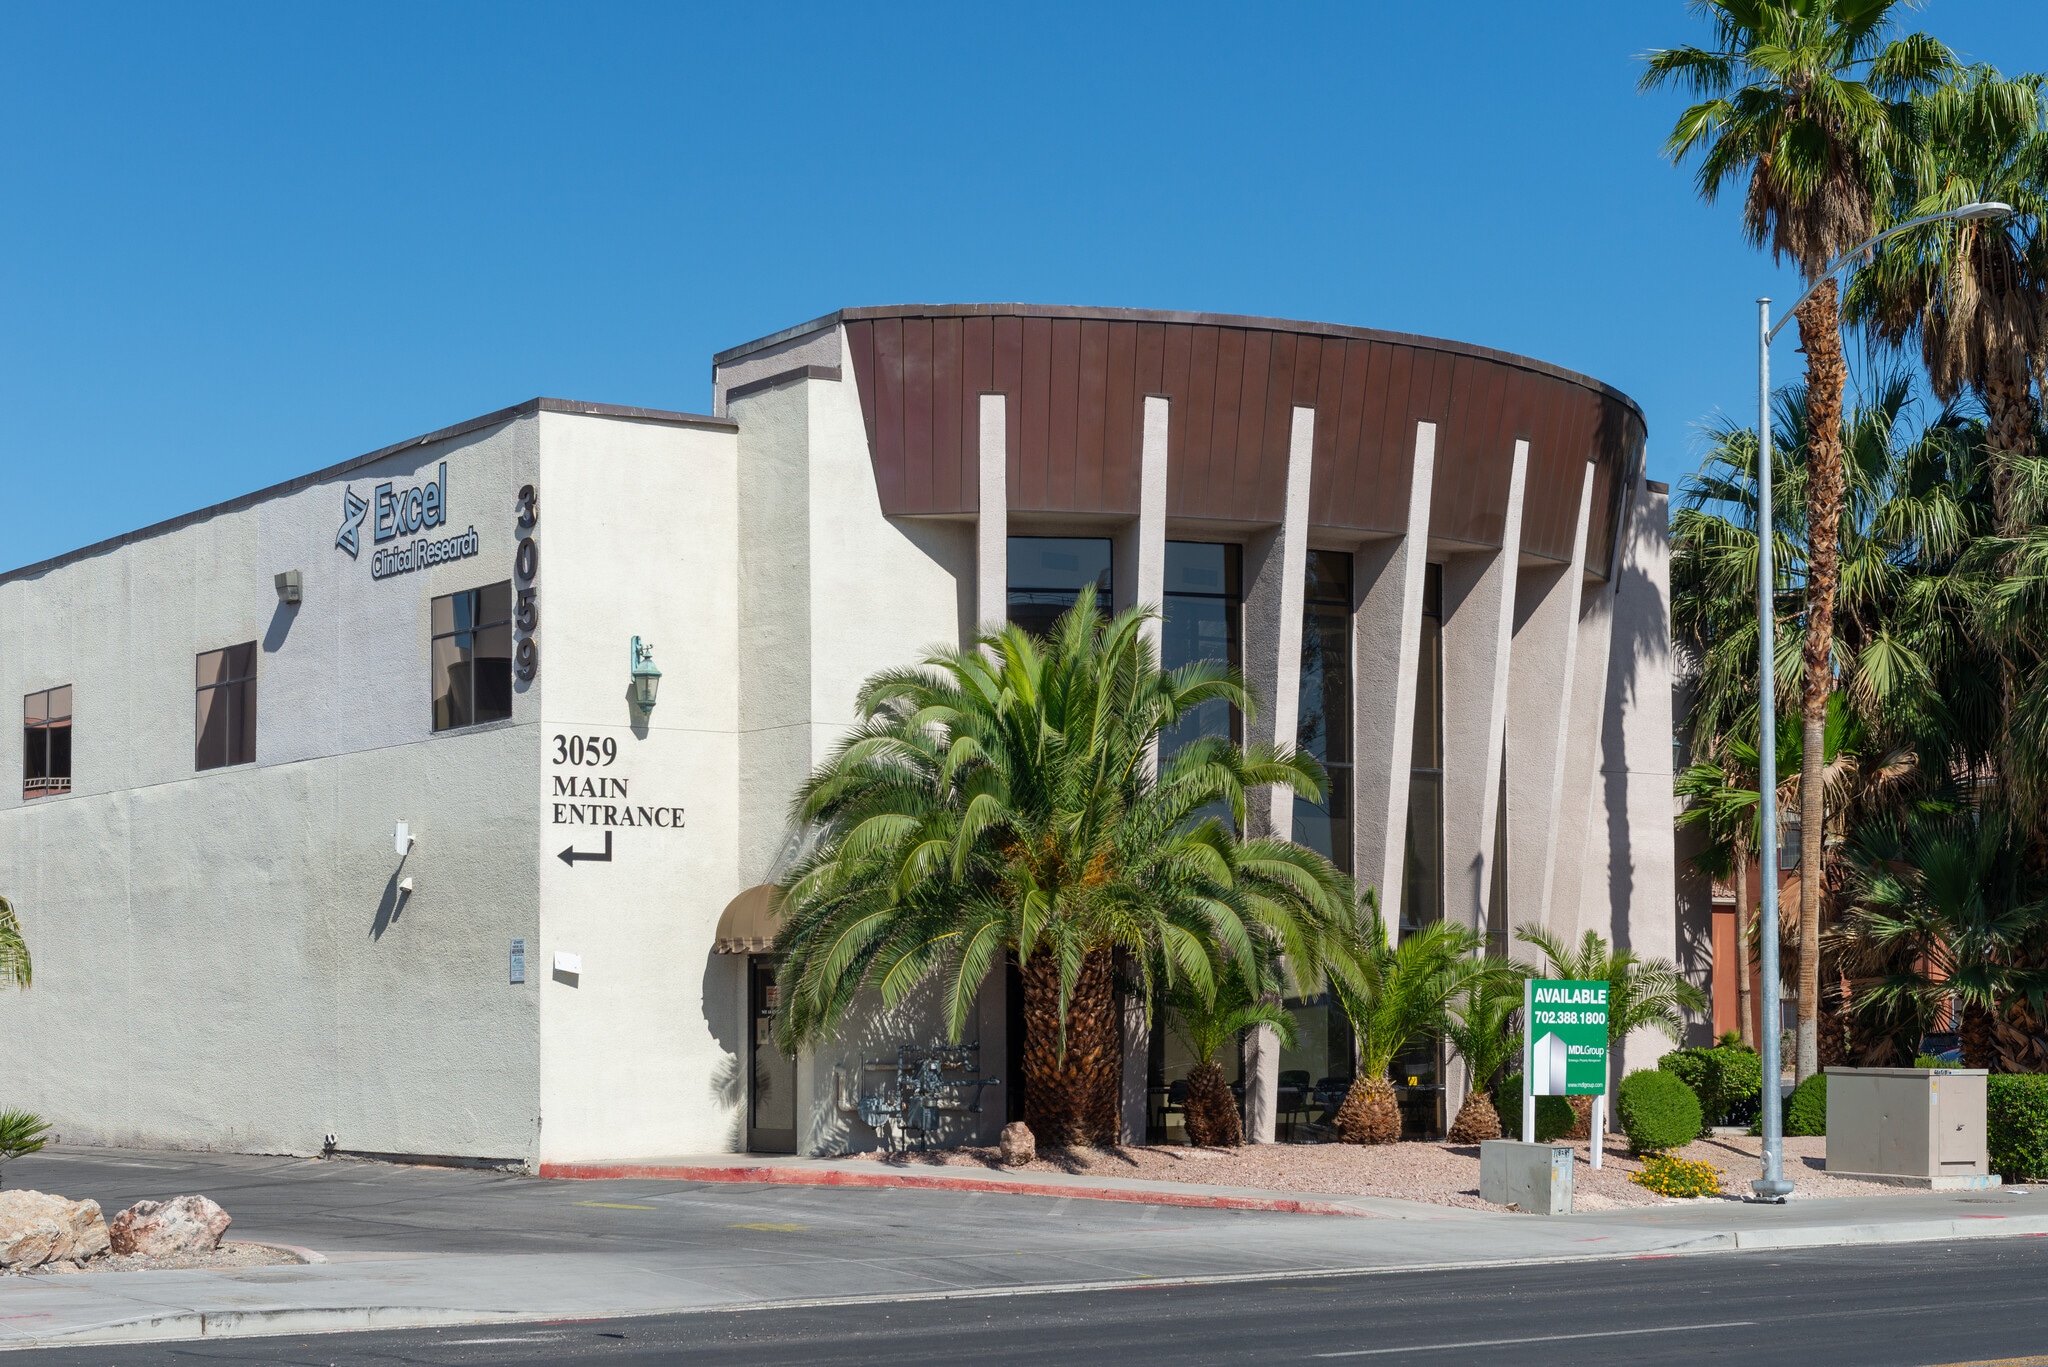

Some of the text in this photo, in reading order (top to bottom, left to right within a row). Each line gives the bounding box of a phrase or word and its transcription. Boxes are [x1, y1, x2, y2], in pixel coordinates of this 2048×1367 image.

[374, 461, 447, 542] Excel
[372, 525, 478, 579] Clinical Research
[516, 484, 538, 681] 3059
[552, 734, 617, 766] 3059
[552, 775, 629, 798] MAIN
[552, 803, 685, 828] ENTRANCE
[1534, 988, 1607, 1004] AVAILABLE
[1534, 1011, 1606, 1025] 702.388.1800
